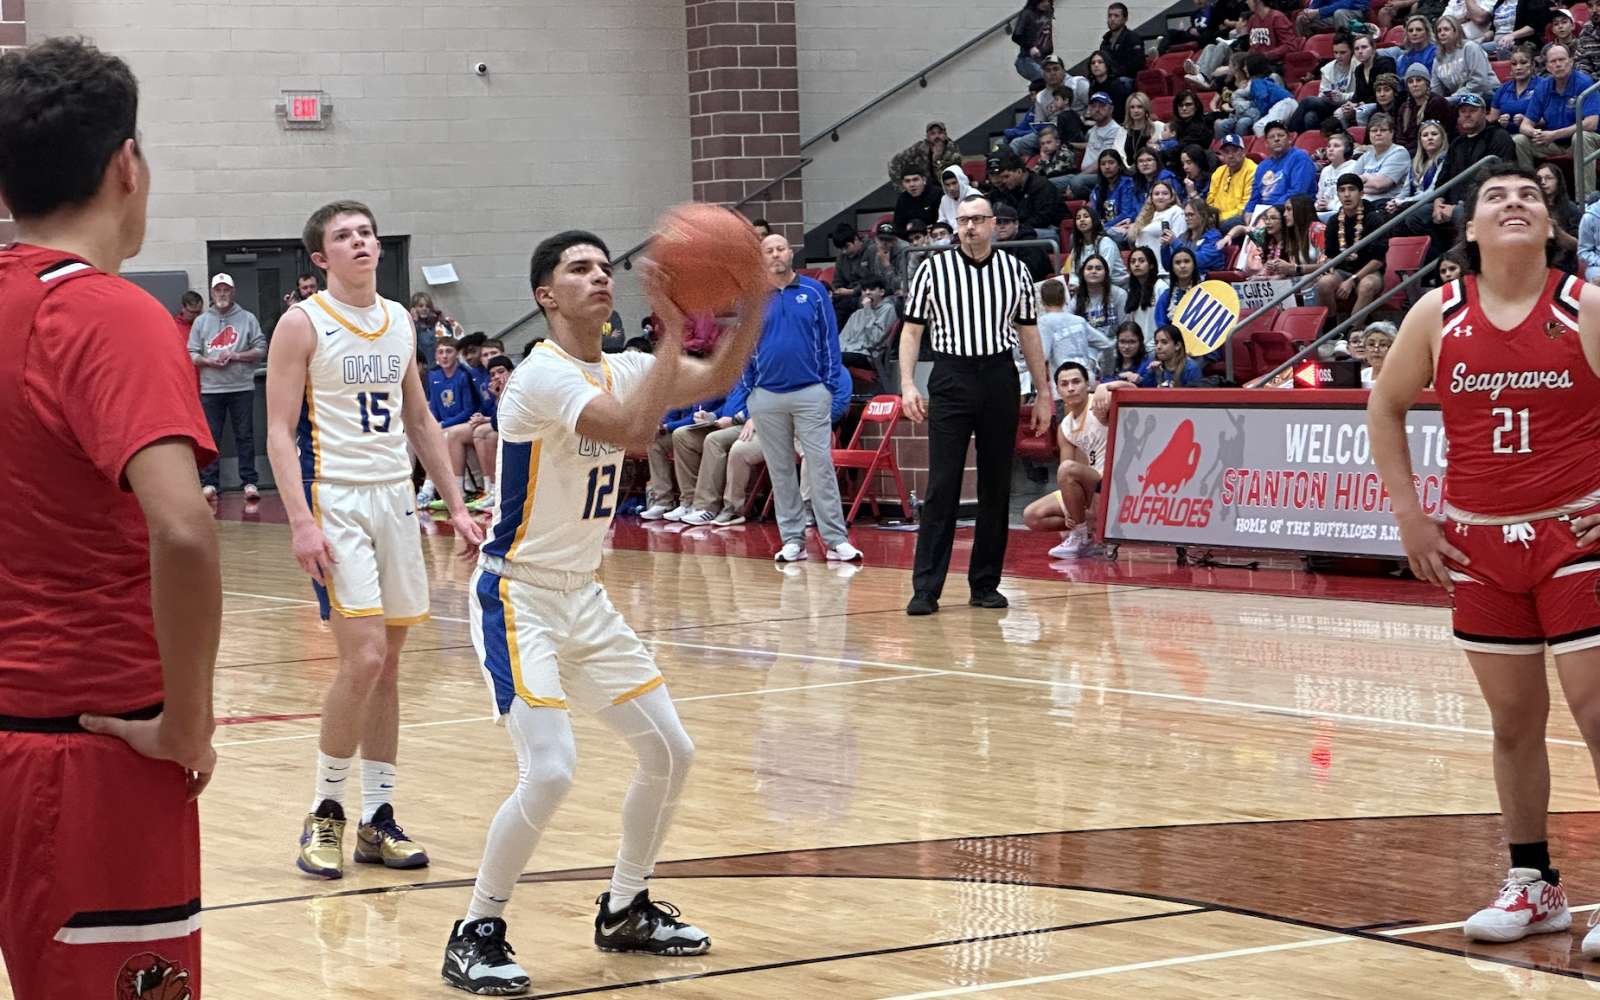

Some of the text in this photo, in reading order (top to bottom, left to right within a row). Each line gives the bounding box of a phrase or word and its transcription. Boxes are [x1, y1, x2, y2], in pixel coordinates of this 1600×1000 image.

[293, 99, 316, 117] EXIT
[1243, 281, 1275, 298] GUESS
[1179, 287, 1235, 348] WIN
[343, 355, 400, 384] OWLS
[1450, 362, 1574, 401] Seagraves
[356, 391, 391, 433] 15
[867, 401, 895, 415] STANTON
[1286, 423, 1448, 468] WELCO TO
[1492, 407, 1532, 454] 21
[583, 465, 616, 519] 12
[1221, 467, 1328, 511] STANTON
[1334, 472, 1393, 512] HIGH
[1118, 495, 1213, 528] BUFFALOES
[1236, 518, 1402, 541] HOME OF THE BUFFALOES AN
